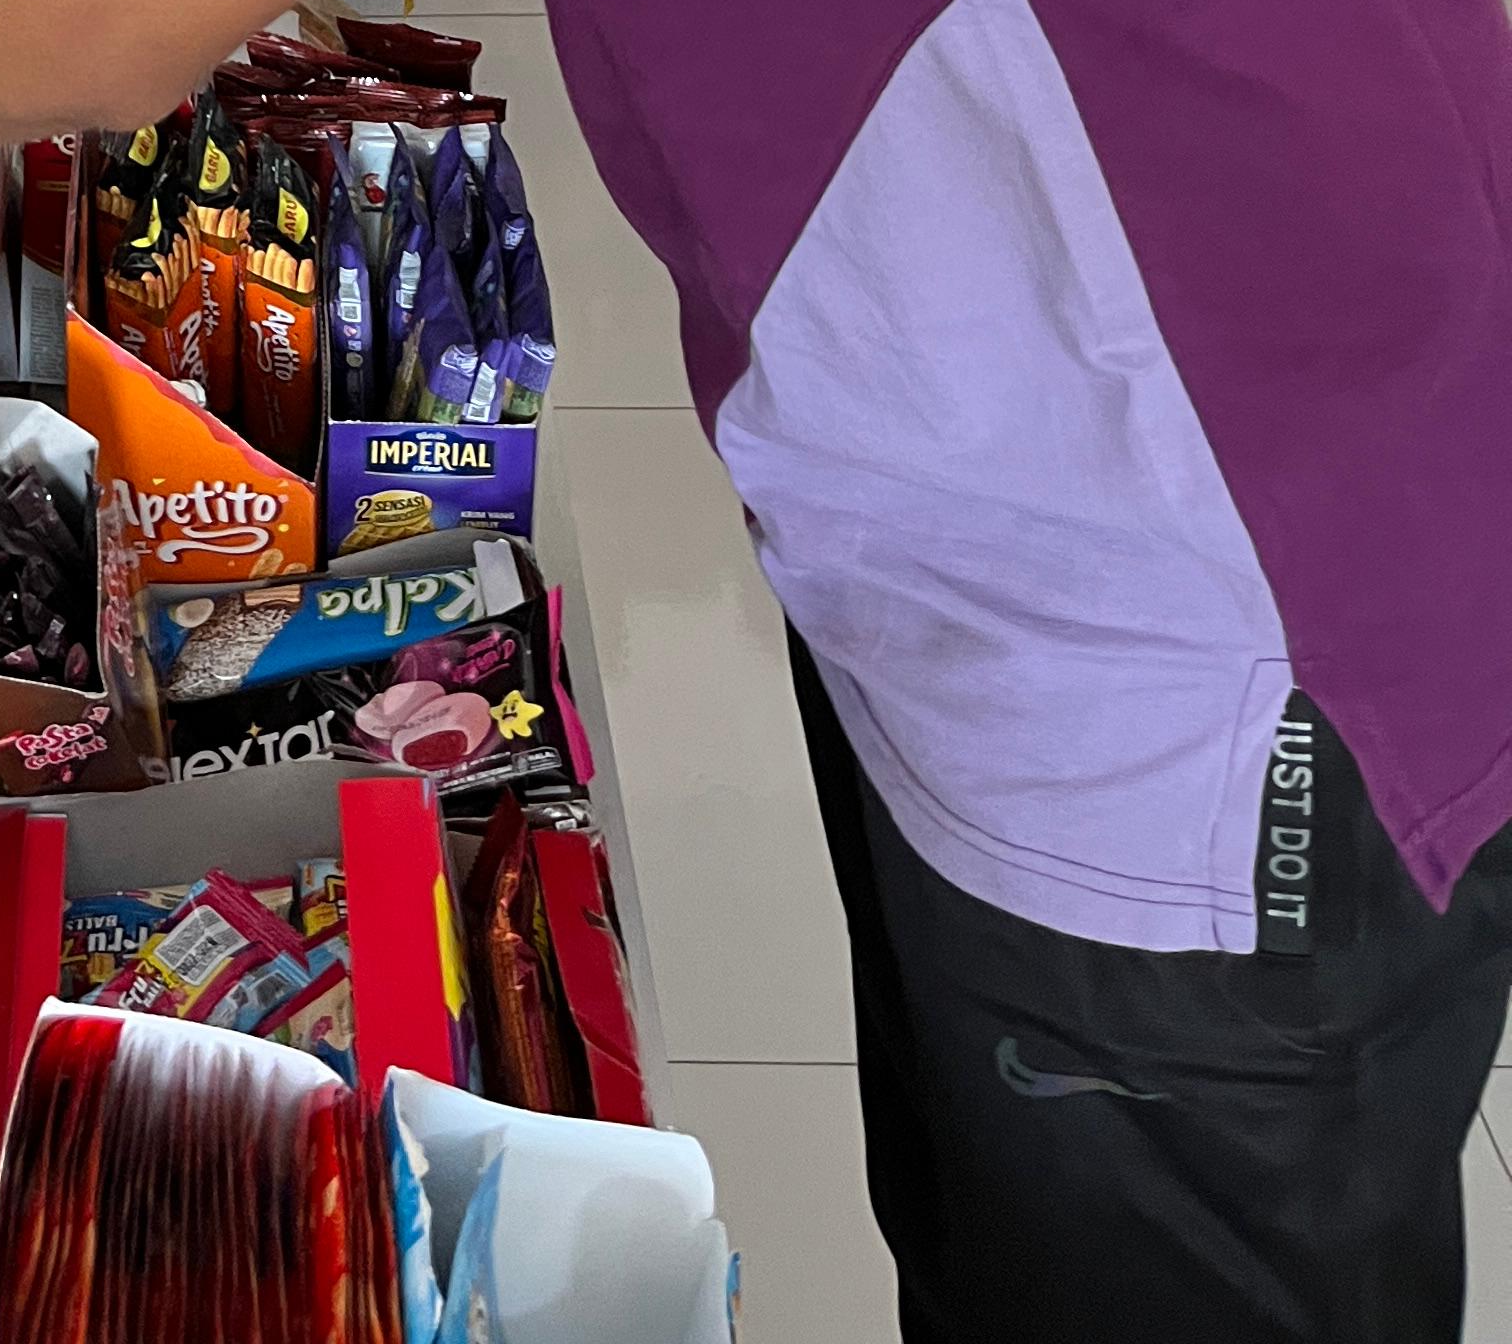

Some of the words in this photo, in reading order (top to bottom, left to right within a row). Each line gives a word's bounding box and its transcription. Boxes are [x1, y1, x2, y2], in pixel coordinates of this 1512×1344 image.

[263, 304, 295, 383] Apetito
[370, 438, 493, 467] IMPERIAL
[112, 478, 278, 542] Apetito
[356, 498, 372, 524] 2
[374, 496, 427, 514] SENSASI
[319, 568, 481, 636] Kalpa
[1267, 825, 1312, 882] DO
[1265, 891, 1308, 928] IT
